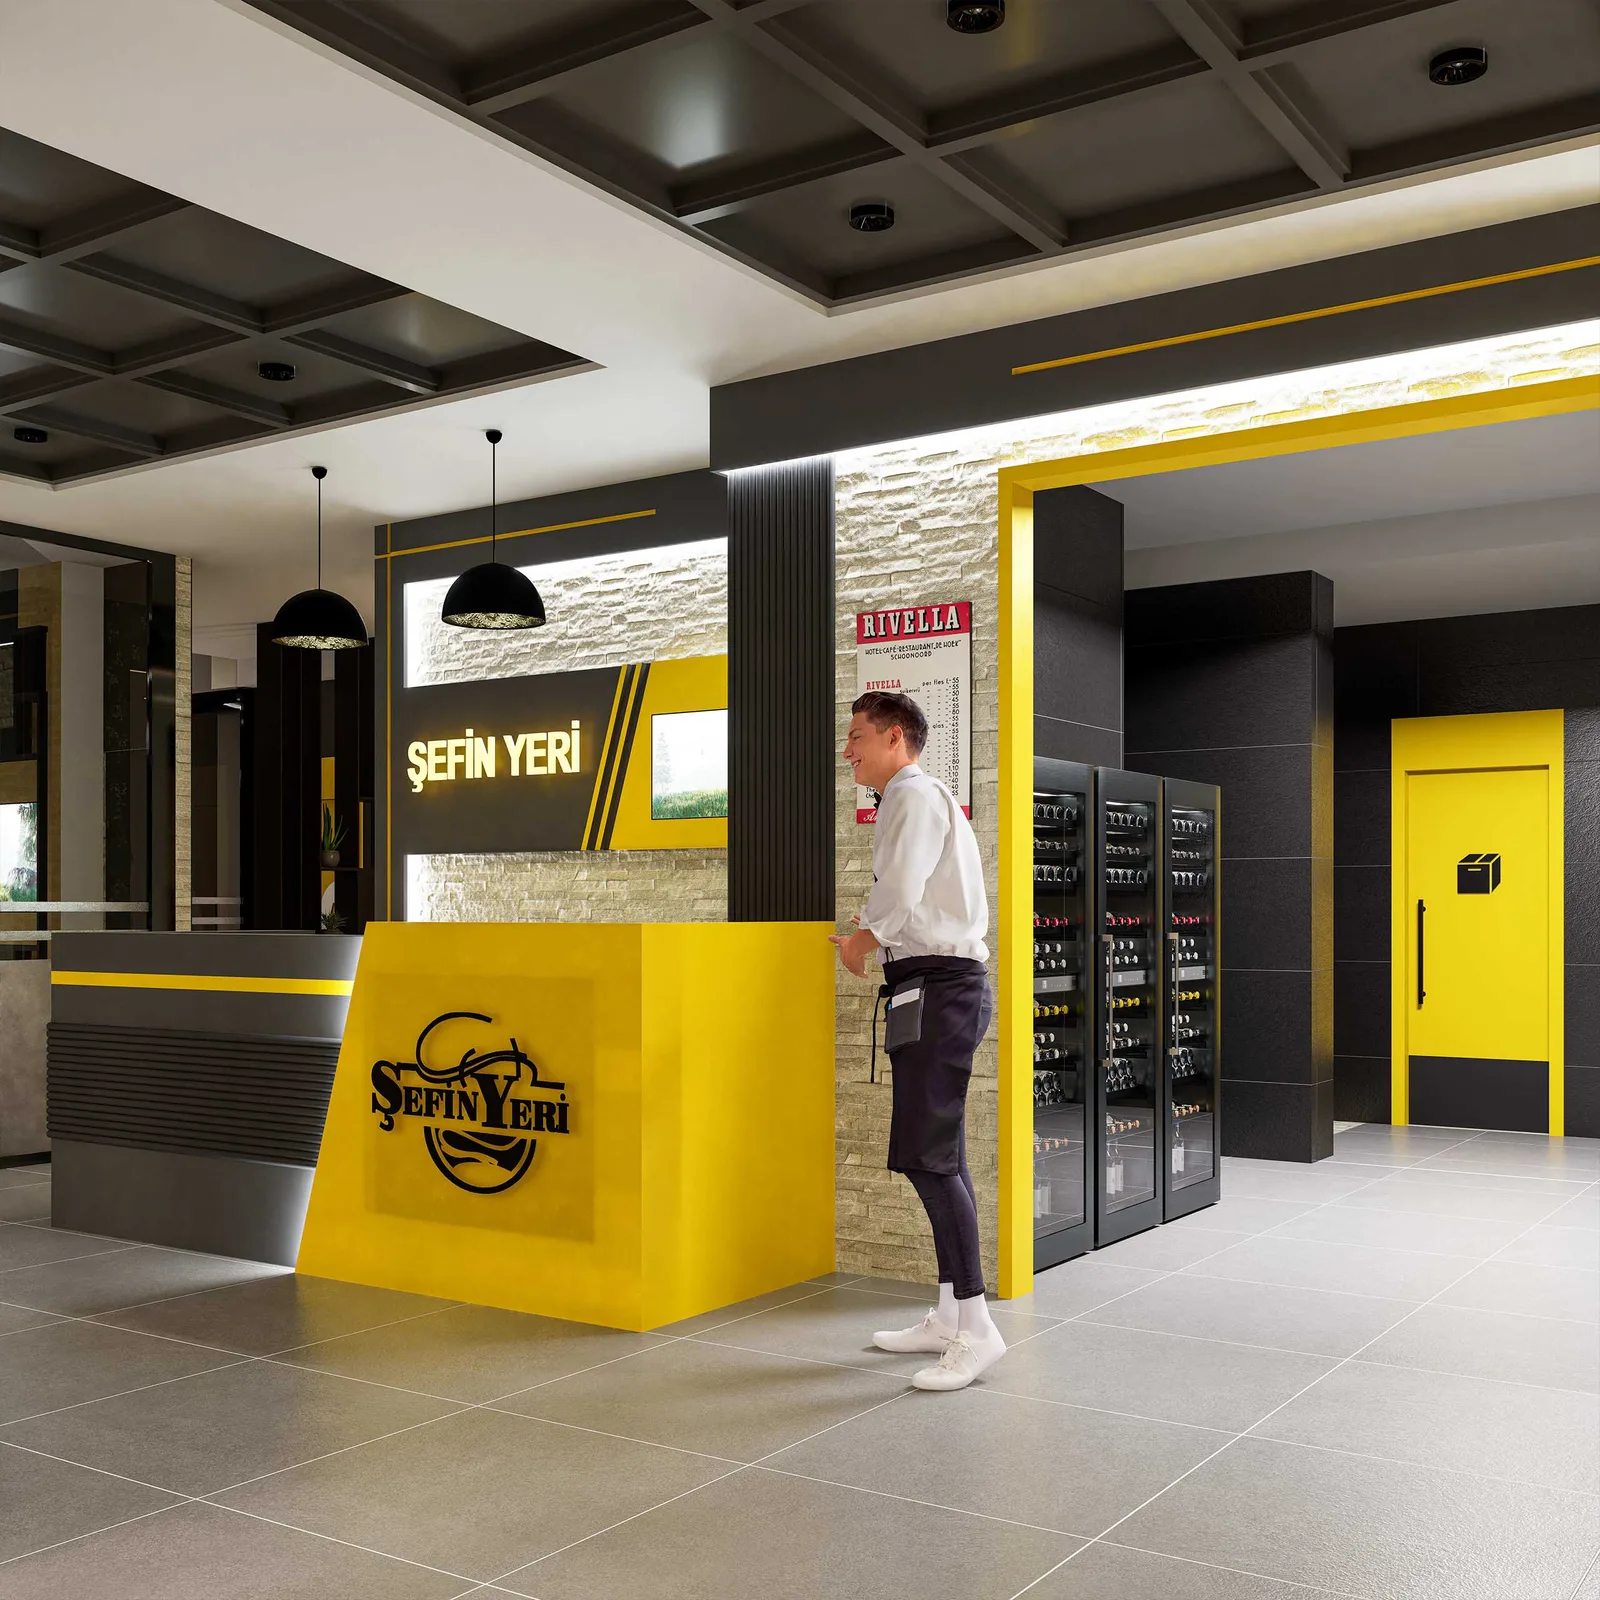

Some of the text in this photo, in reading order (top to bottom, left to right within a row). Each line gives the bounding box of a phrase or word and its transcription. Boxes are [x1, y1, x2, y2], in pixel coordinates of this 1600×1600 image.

[862, 605, 960, 638] RIVELLA
[891, 650, 932, 660] SCHOONOORD
[866, 679, 901, 690] RIVELLA
[407, 720, 580, 793] ŞEFİN YERİ
